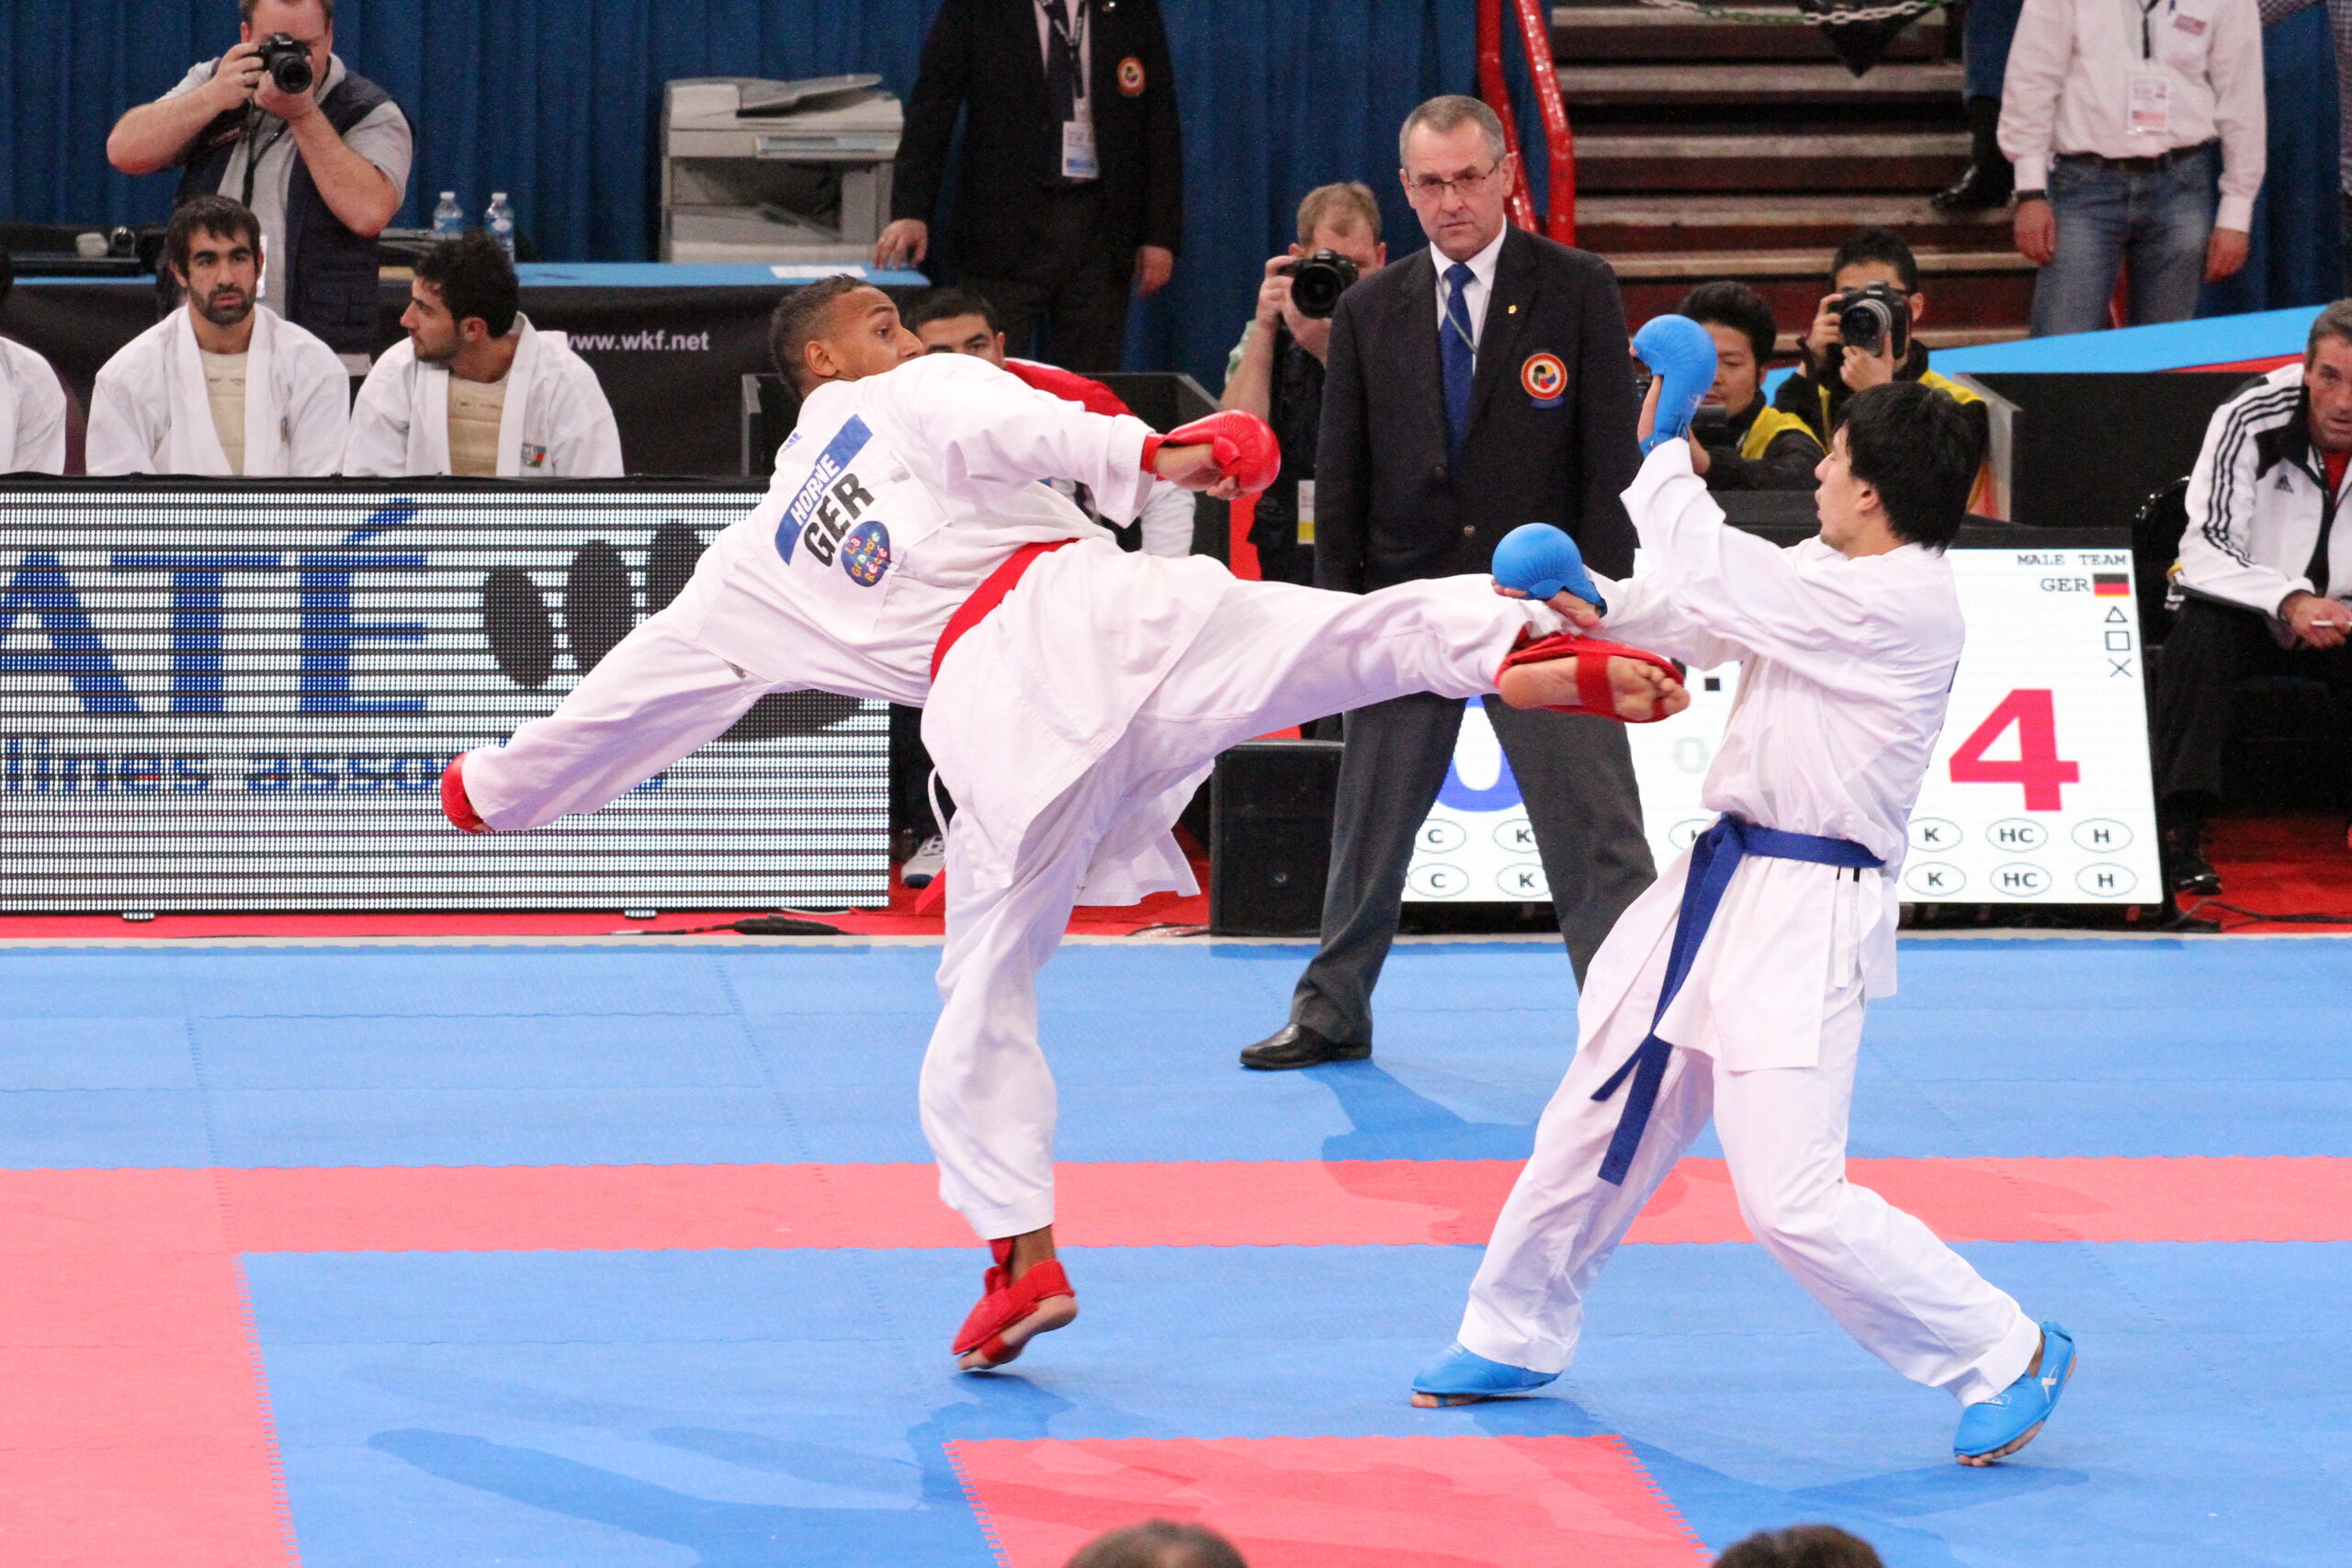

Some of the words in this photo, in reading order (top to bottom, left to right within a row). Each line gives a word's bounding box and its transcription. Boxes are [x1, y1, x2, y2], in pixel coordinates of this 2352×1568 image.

[790, 454, 841, 526] HORNE
[804, 472, 875, 567] GER
[2017, 554, 2064, 566] MALE
[2078, 554, 2128, 566] TEAM
[2040, 578, 2090, 592] GER
[1948, 688, 2080, 811] 4
[1427, 829, 1443, 844] C
[1516, 829, 1532, 843] K
[1924, 828, 1940, 842] K
[1999, 828, 2034, 843] HC
[2094, 829, 2110, 844] H
[1430, 873, 1446, 889] C
[1519, 874, 1535, 887] K
[1928, 873, 1944, 887] K
[2003, 873, 2038, 887] HC
[2098, 874, 2114, 888] H
